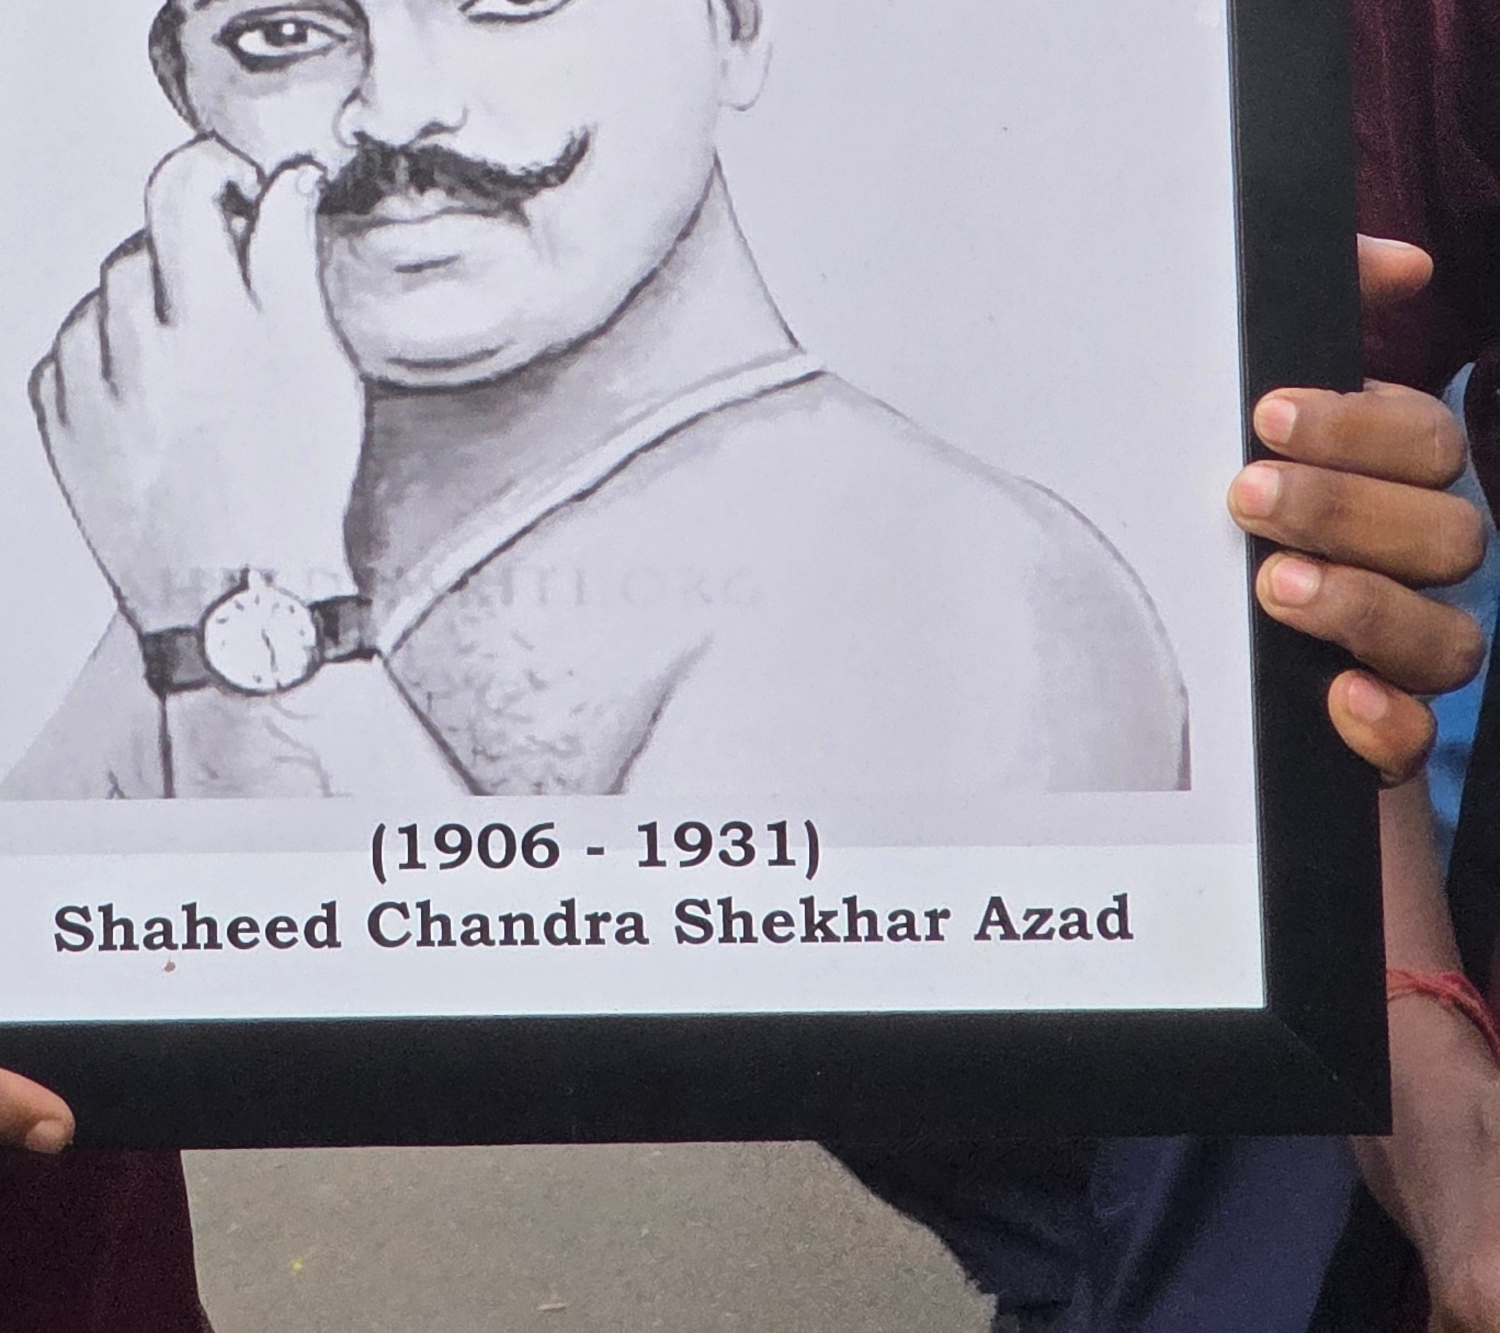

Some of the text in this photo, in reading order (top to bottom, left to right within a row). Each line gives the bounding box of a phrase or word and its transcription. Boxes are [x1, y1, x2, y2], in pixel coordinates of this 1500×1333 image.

[373, 819, 818, 884] (1906 - 1931)
[54, 892, 1133, 951] Shaheed Chandra Shekhar Azad
